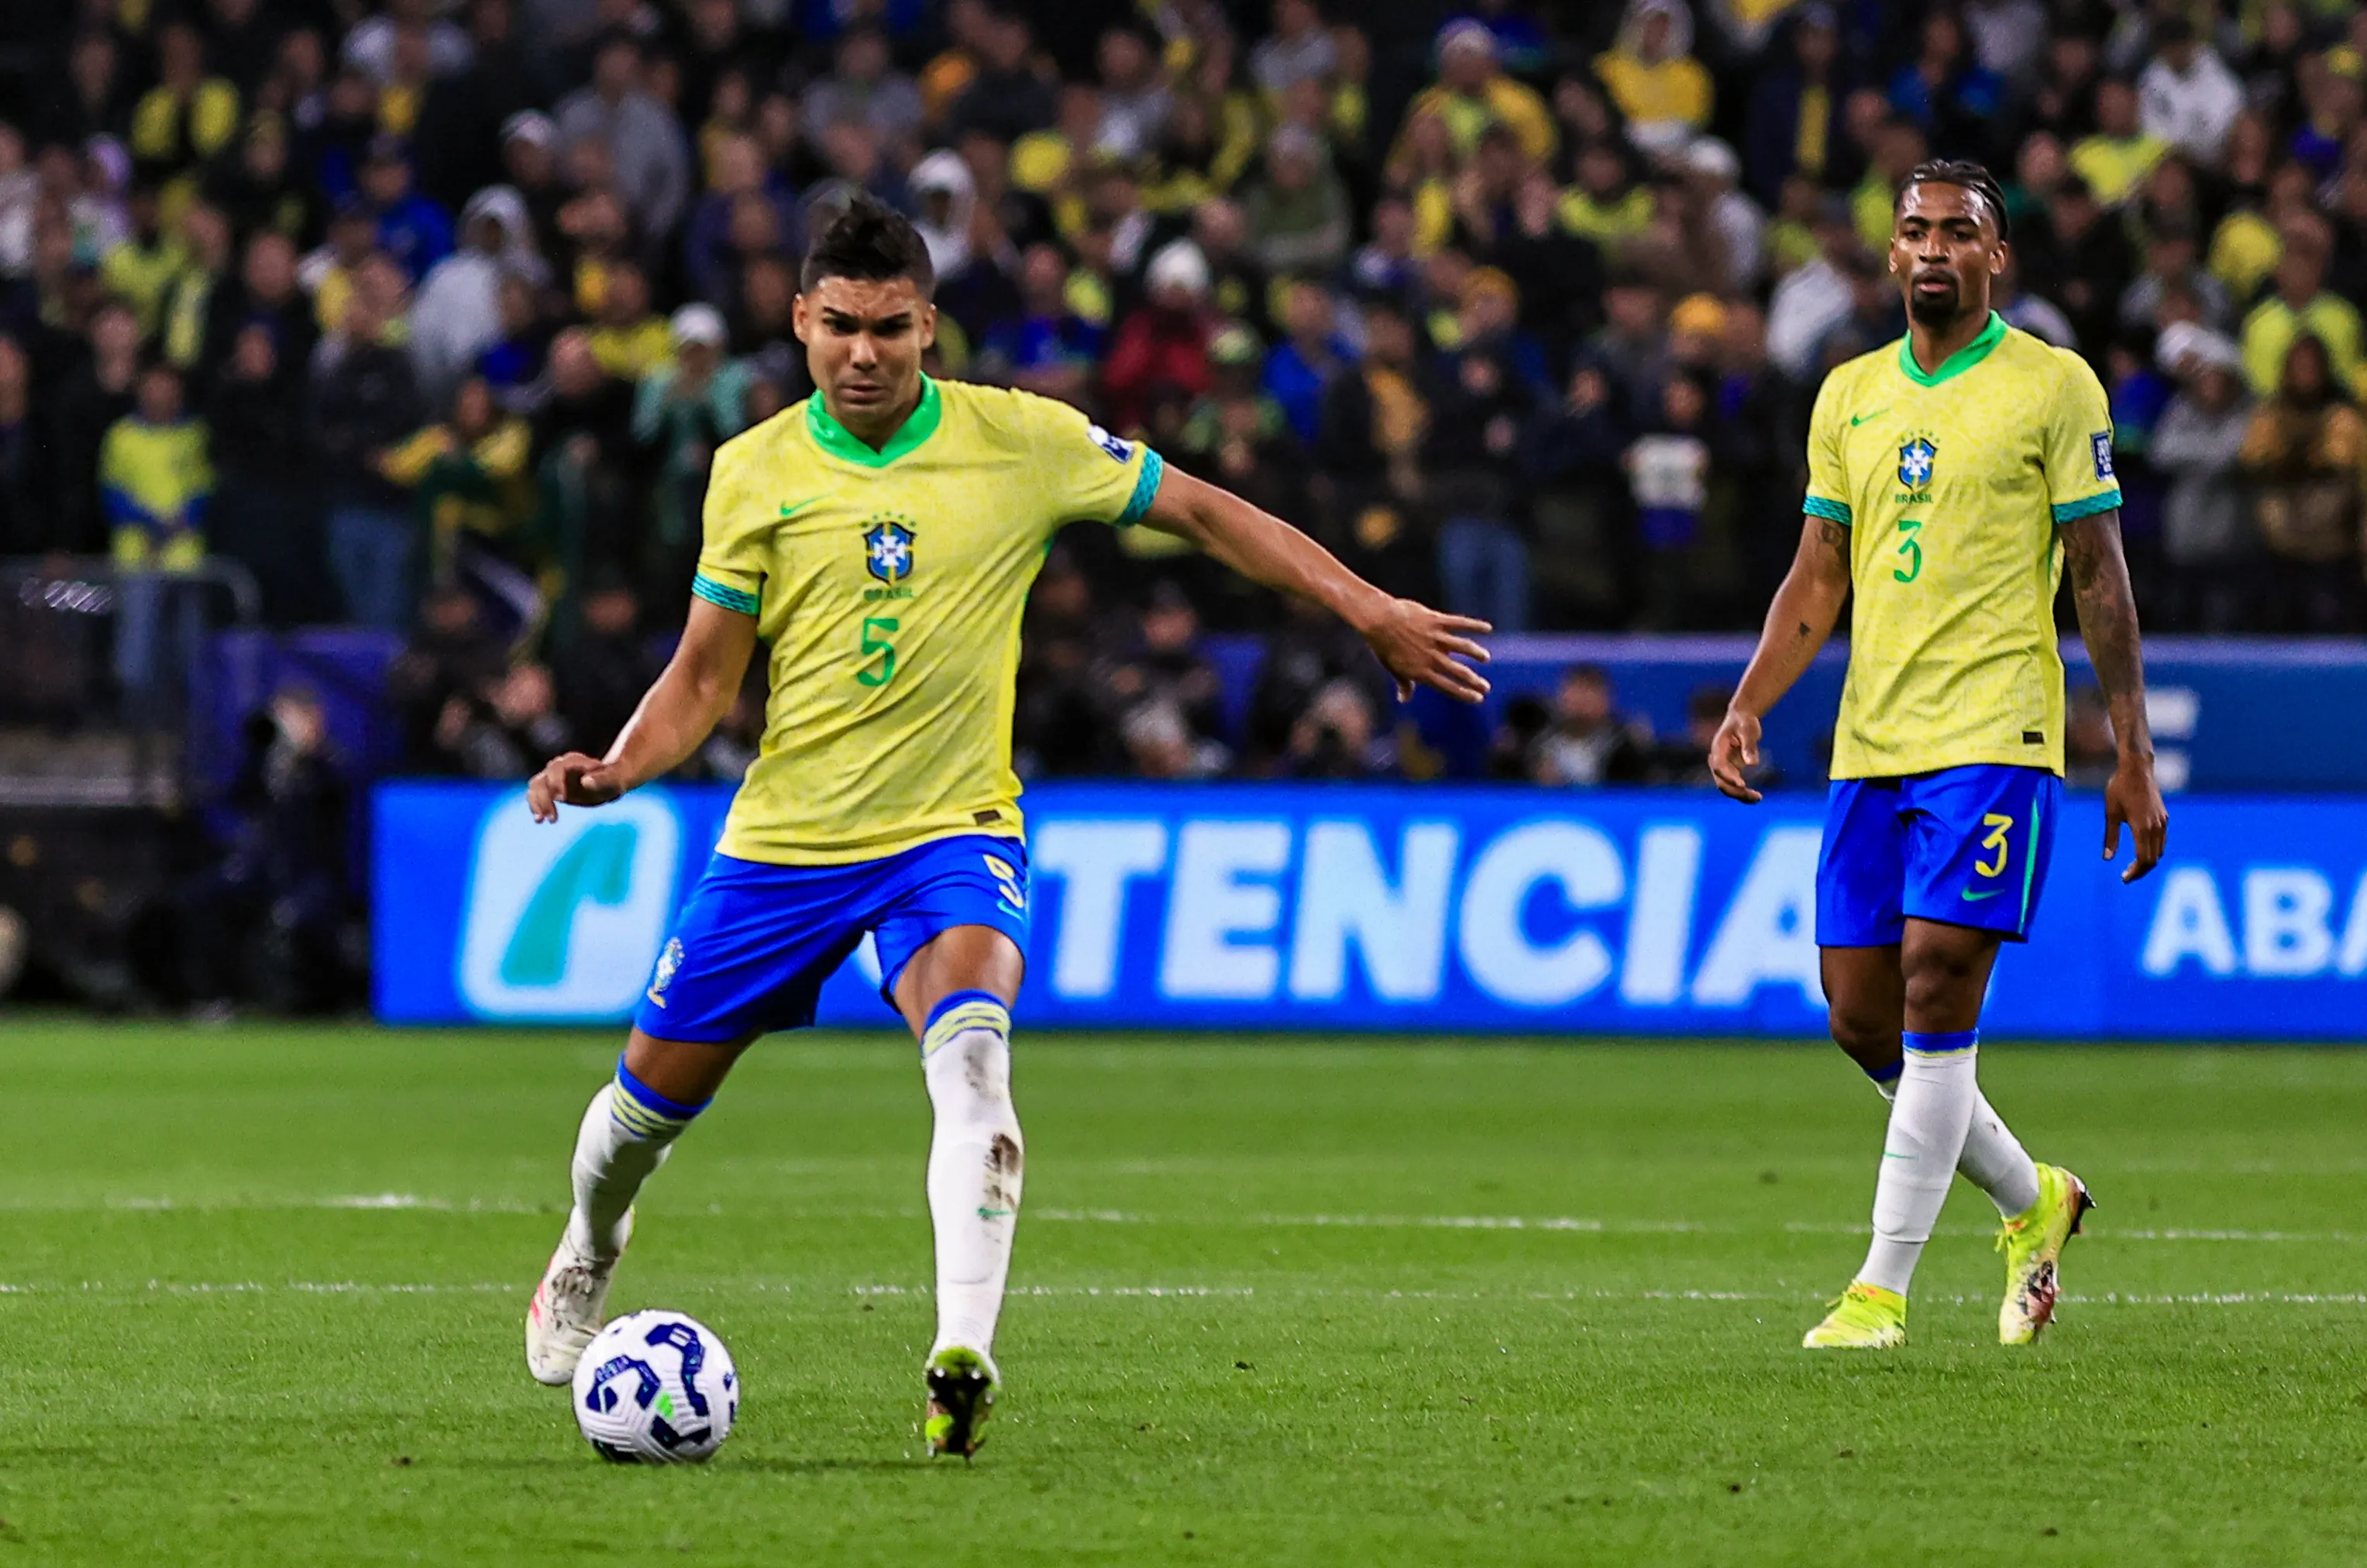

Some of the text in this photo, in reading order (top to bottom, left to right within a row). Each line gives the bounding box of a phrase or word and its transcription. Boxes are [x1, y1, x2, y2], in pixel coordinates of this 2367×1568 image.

[1894, 492, 1934, 505] BRASIL
[1893, 519, 1923, 584] 3
[855, 617, 900, 688] 5
[1975, 813, 2014, 878] 3
